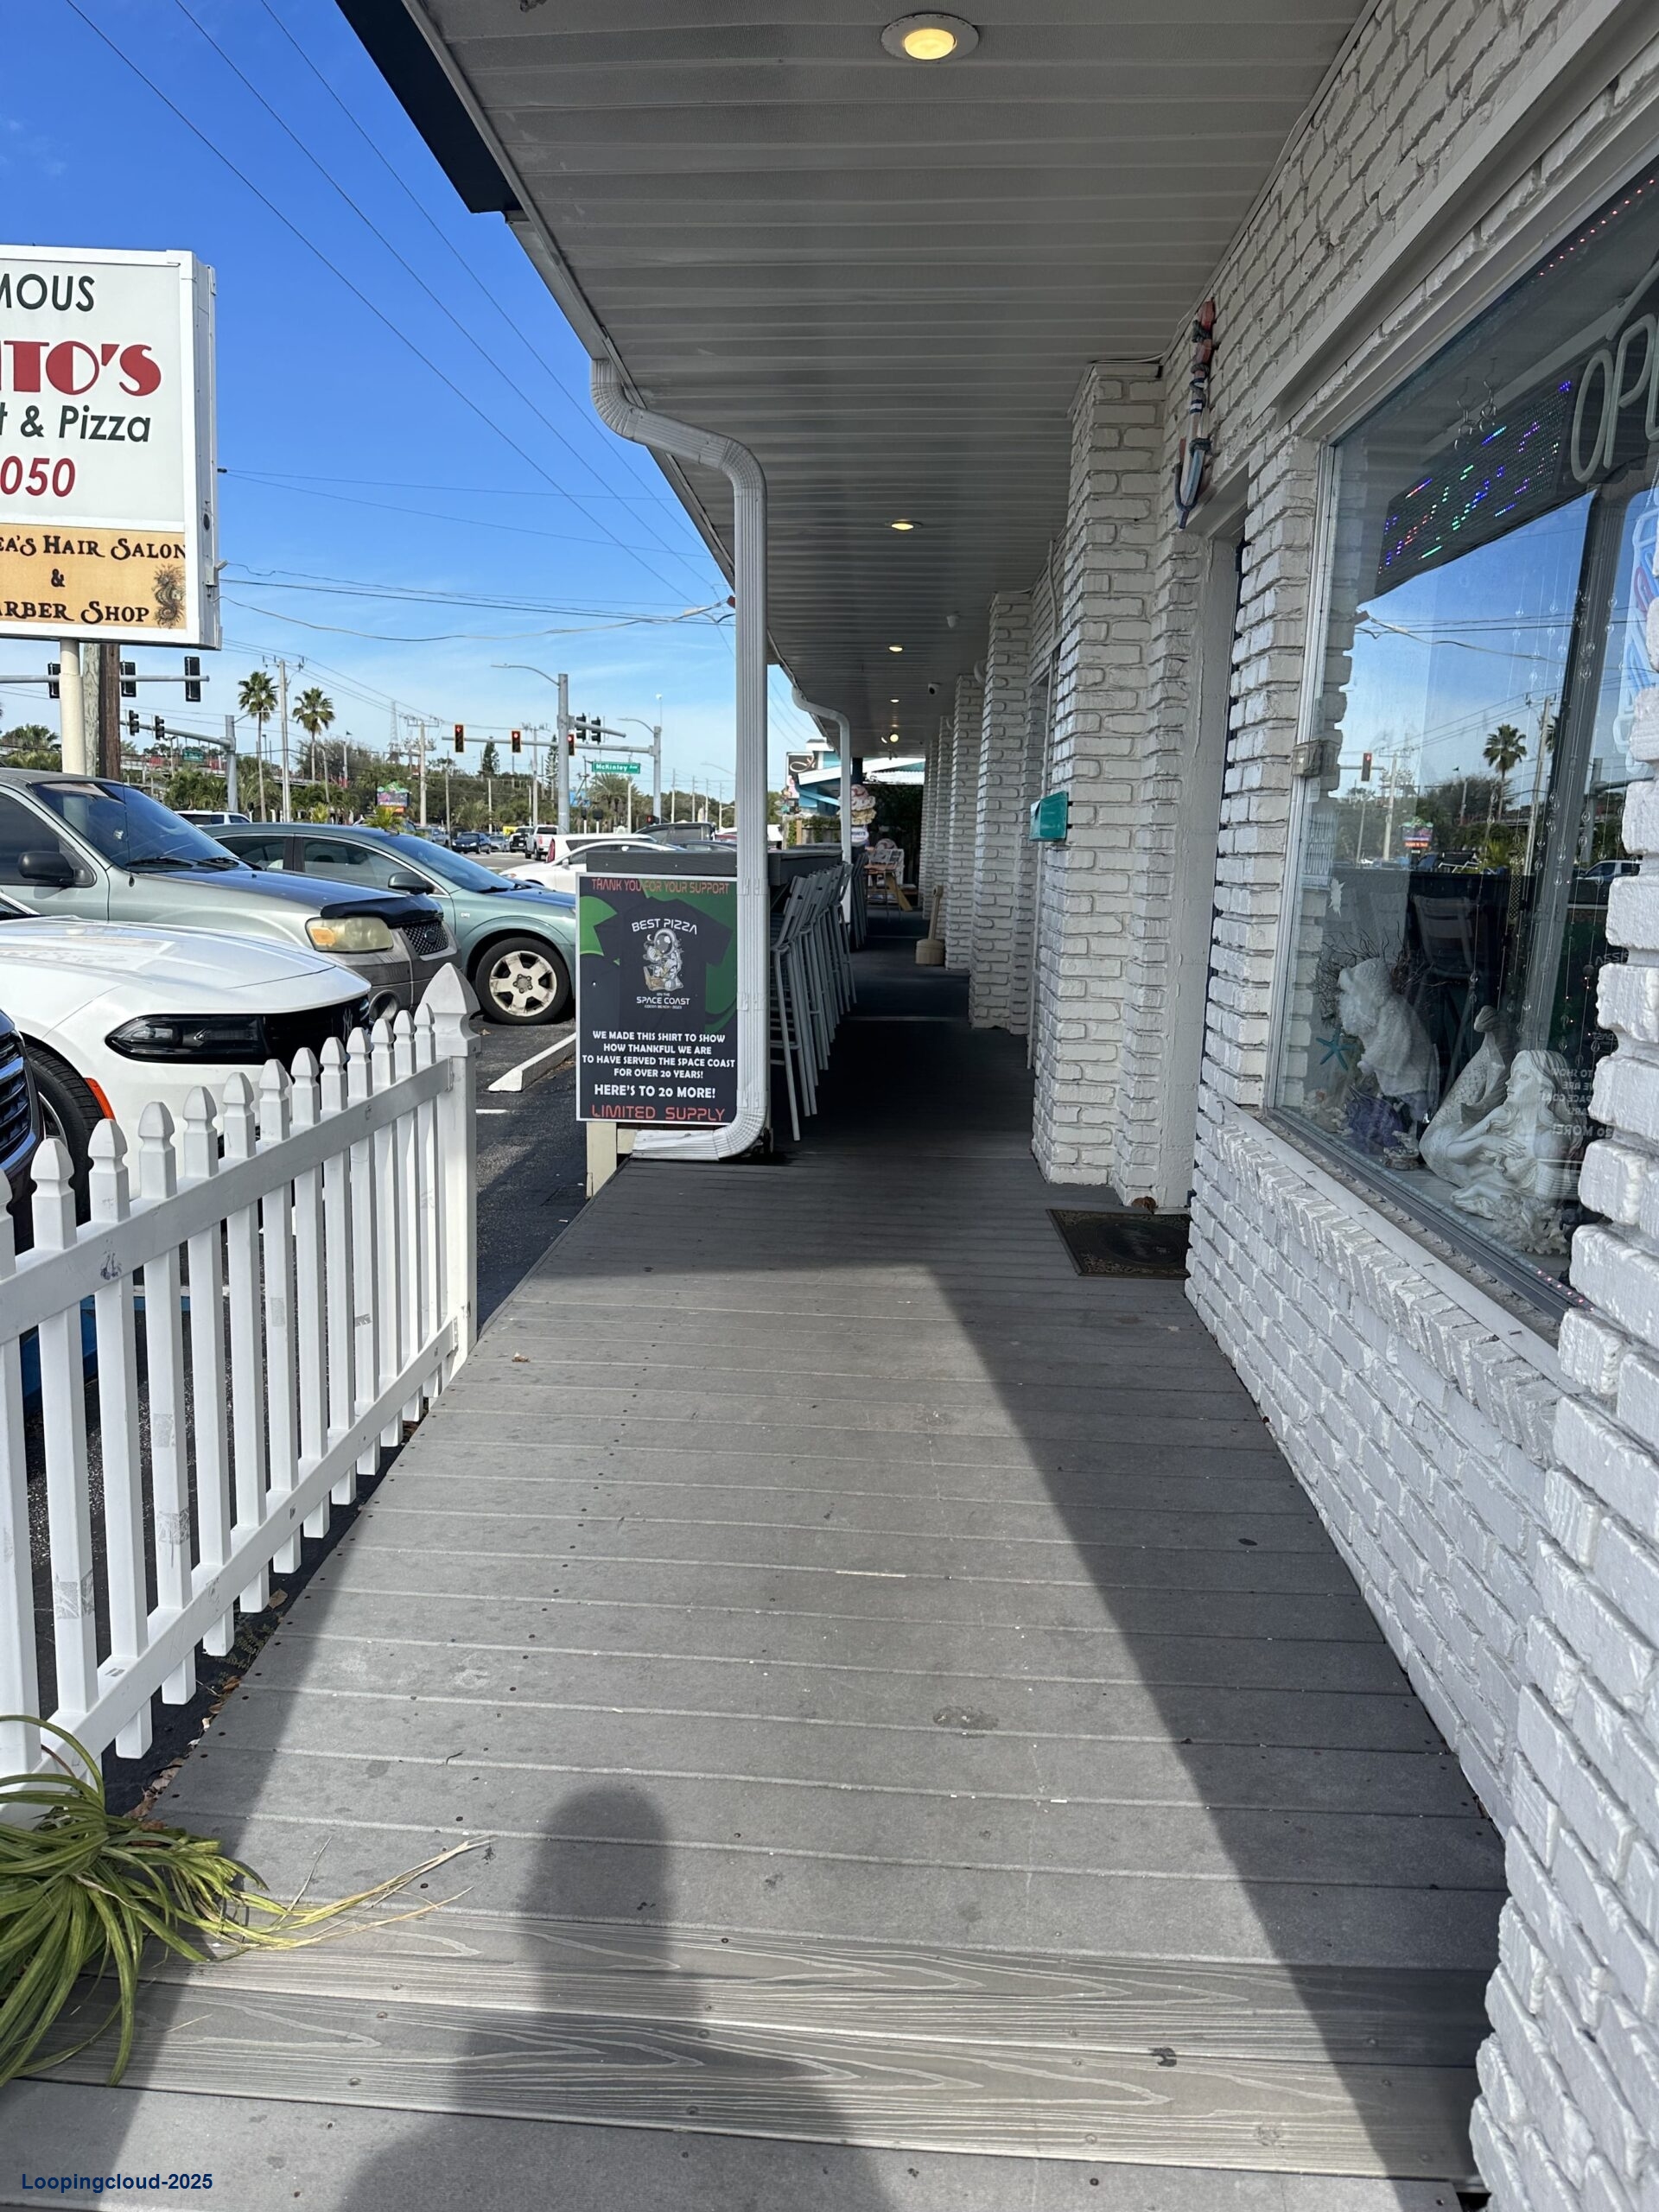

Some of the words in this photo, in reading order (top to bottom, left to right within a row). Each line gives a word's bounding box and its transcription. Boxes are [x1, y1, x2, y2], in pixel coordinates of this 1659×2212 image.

[21, 405, 44, 437] &
[59, 404, 151, 442] Pizza
[50, 569, 66, 588] &
[0, 601, 74, 622] RBER
[596, 763, 627, 772] McKinley
[592, 878, 622, 891] THANK
[624, 879, 642, 892] YOU
[643, 880, 661, 893] FOR
[664, 880, 688, 893] YOUR
[689, 881, 729, 894] SUPPORT
[632, 918, 660, 932] BEST
[664, 918, 696, 935] PIZZA
[593, 1030, 607, 1039] WE
[608, 1031, 634, 1040] MADE
[637, 1032, 655, 1041] THIS
[658, 1033, 683, 1042] SHIRT
[684, 1033, 696, 1042] TO
[699, 1033, 726, 1043] SHOW
[603, 1043, 626, 1052] HOW
[628, 1044, 676, 1054] THANKFUL
[677, 1046, 692, 1054] WE
[694, 1046, 712, 1055] ARE
[582, 1055, 594, 1064] TO
[596, 1055, 621, 1065] HAVE
[623, 1056, 656, 1065] SERVED
[658, 1057, 676, 1065] THE
[677, 1058, 705, 1067] SPACE
[707, 1058, 735, 1068] COAST
[613, 1068, 632, 1077] FOR
[634, 1069, 658, 1077] OVER
[674, 1070, 703, 1078] YEARS!
[594, 1084, 636, 1096] HERE'S
[639, 1085, 656, 1097] TO
[658, 1087, 673, 1097] 20
[677, 1086, 716, 1098] MORE!
[591, 1104, 656, 1119] LIMITED
[665, 1107, 725, 1122] SUPPLY
